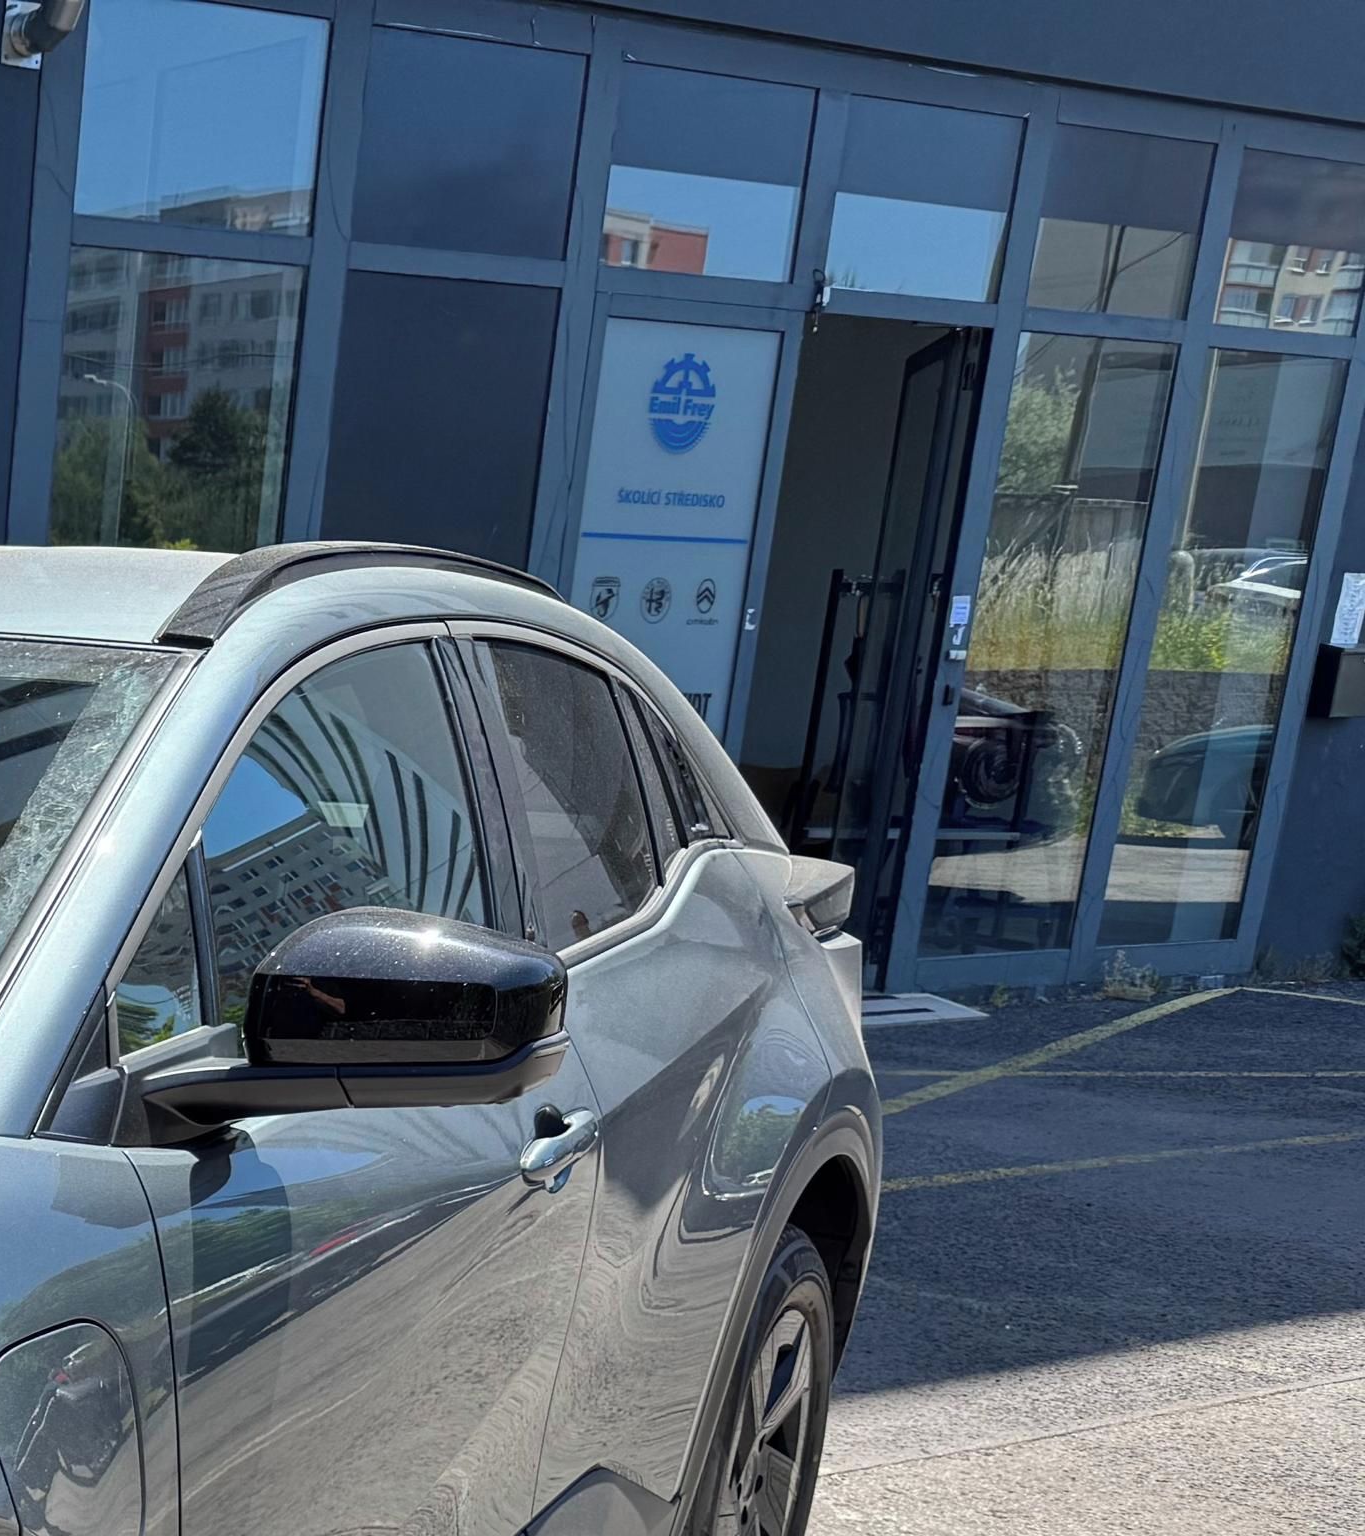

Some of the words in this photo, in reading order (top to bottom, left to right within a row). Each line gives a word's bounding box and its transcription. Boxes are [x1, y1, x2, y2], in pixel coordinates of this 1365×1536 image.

[648, 396, 681, 415] Emil
[682, 398, 715, 421] Frey
[664, 490, 726, 509] STŘEDISKO
